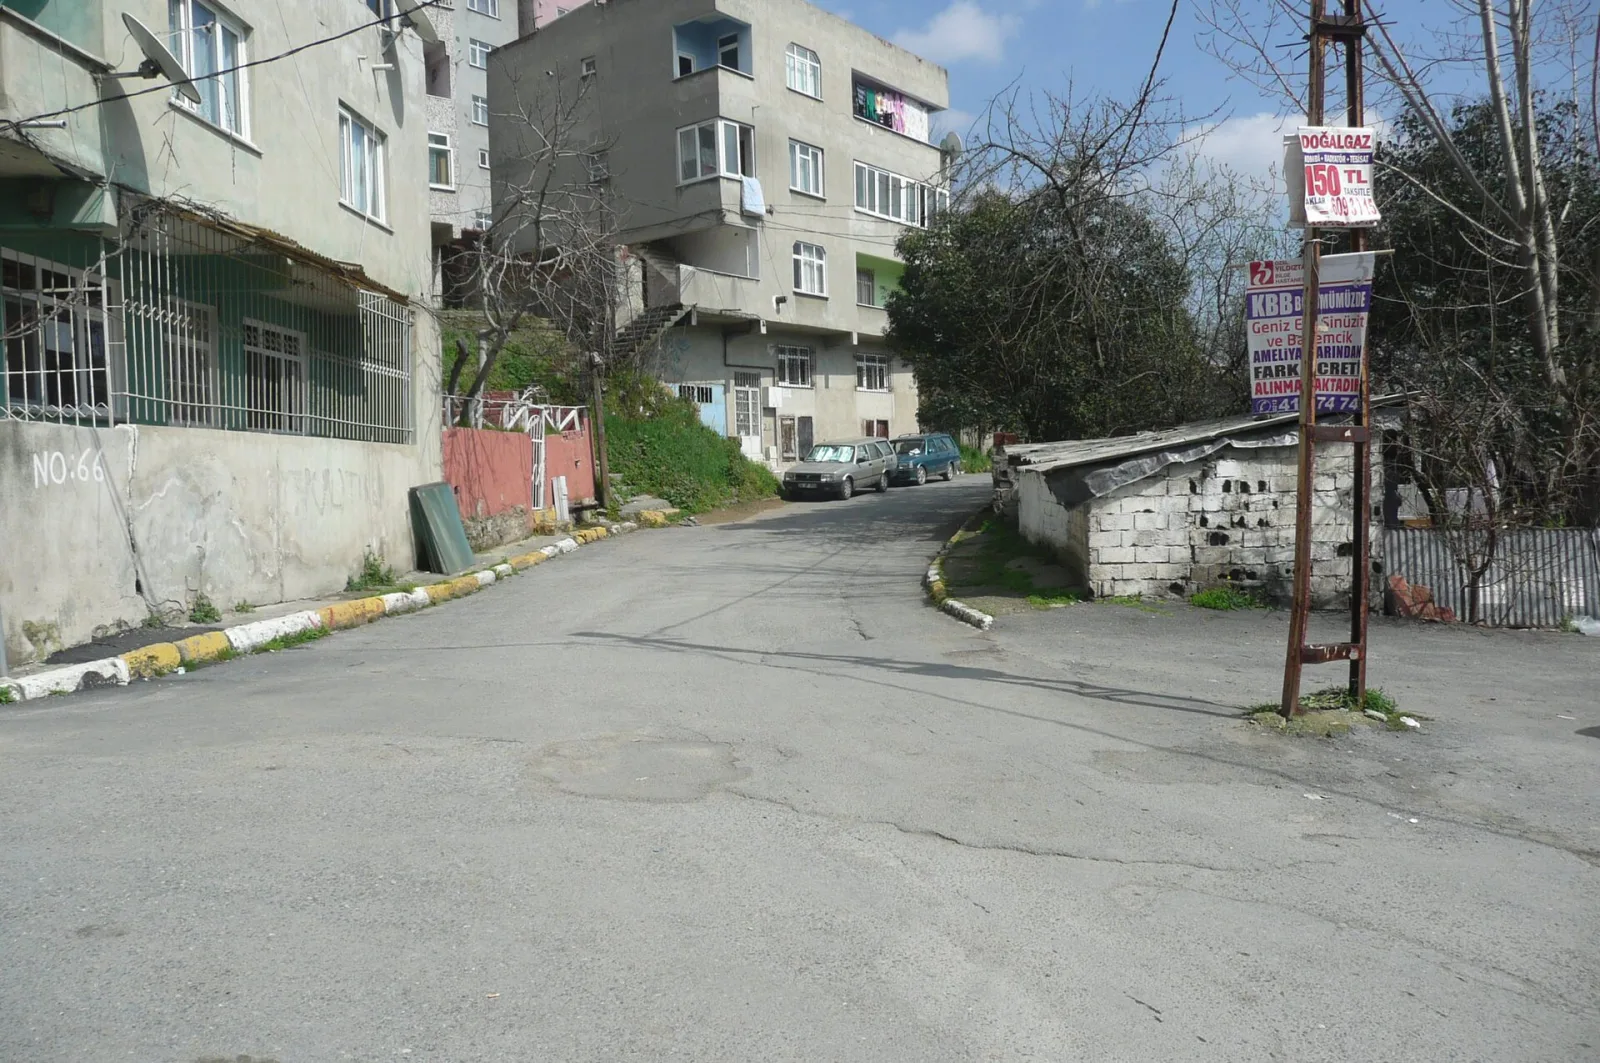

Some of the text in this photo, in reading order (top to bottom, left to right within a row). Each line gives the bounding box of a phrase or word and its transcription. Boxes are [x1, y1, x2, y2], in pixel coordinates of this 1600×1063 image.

[1301, 131, 1371, 149] DOĞALGAZ
[1305, 165, 1367, 196] 150 TL
[1251, 292, 1293, 317] KBB
[1252, 319, 1290, 333] Geniz
[1267, 331, 1352, 347] ve Baemcik
[1254, 364, 1299, 379] FARK
[1255, 378, 1360, 395] ALINMAAKTADIR
[1317, 396, 1335, 411] 74
[1340, 396, 1358, 411] 74
[33, 448, 104, 488] NO:66
